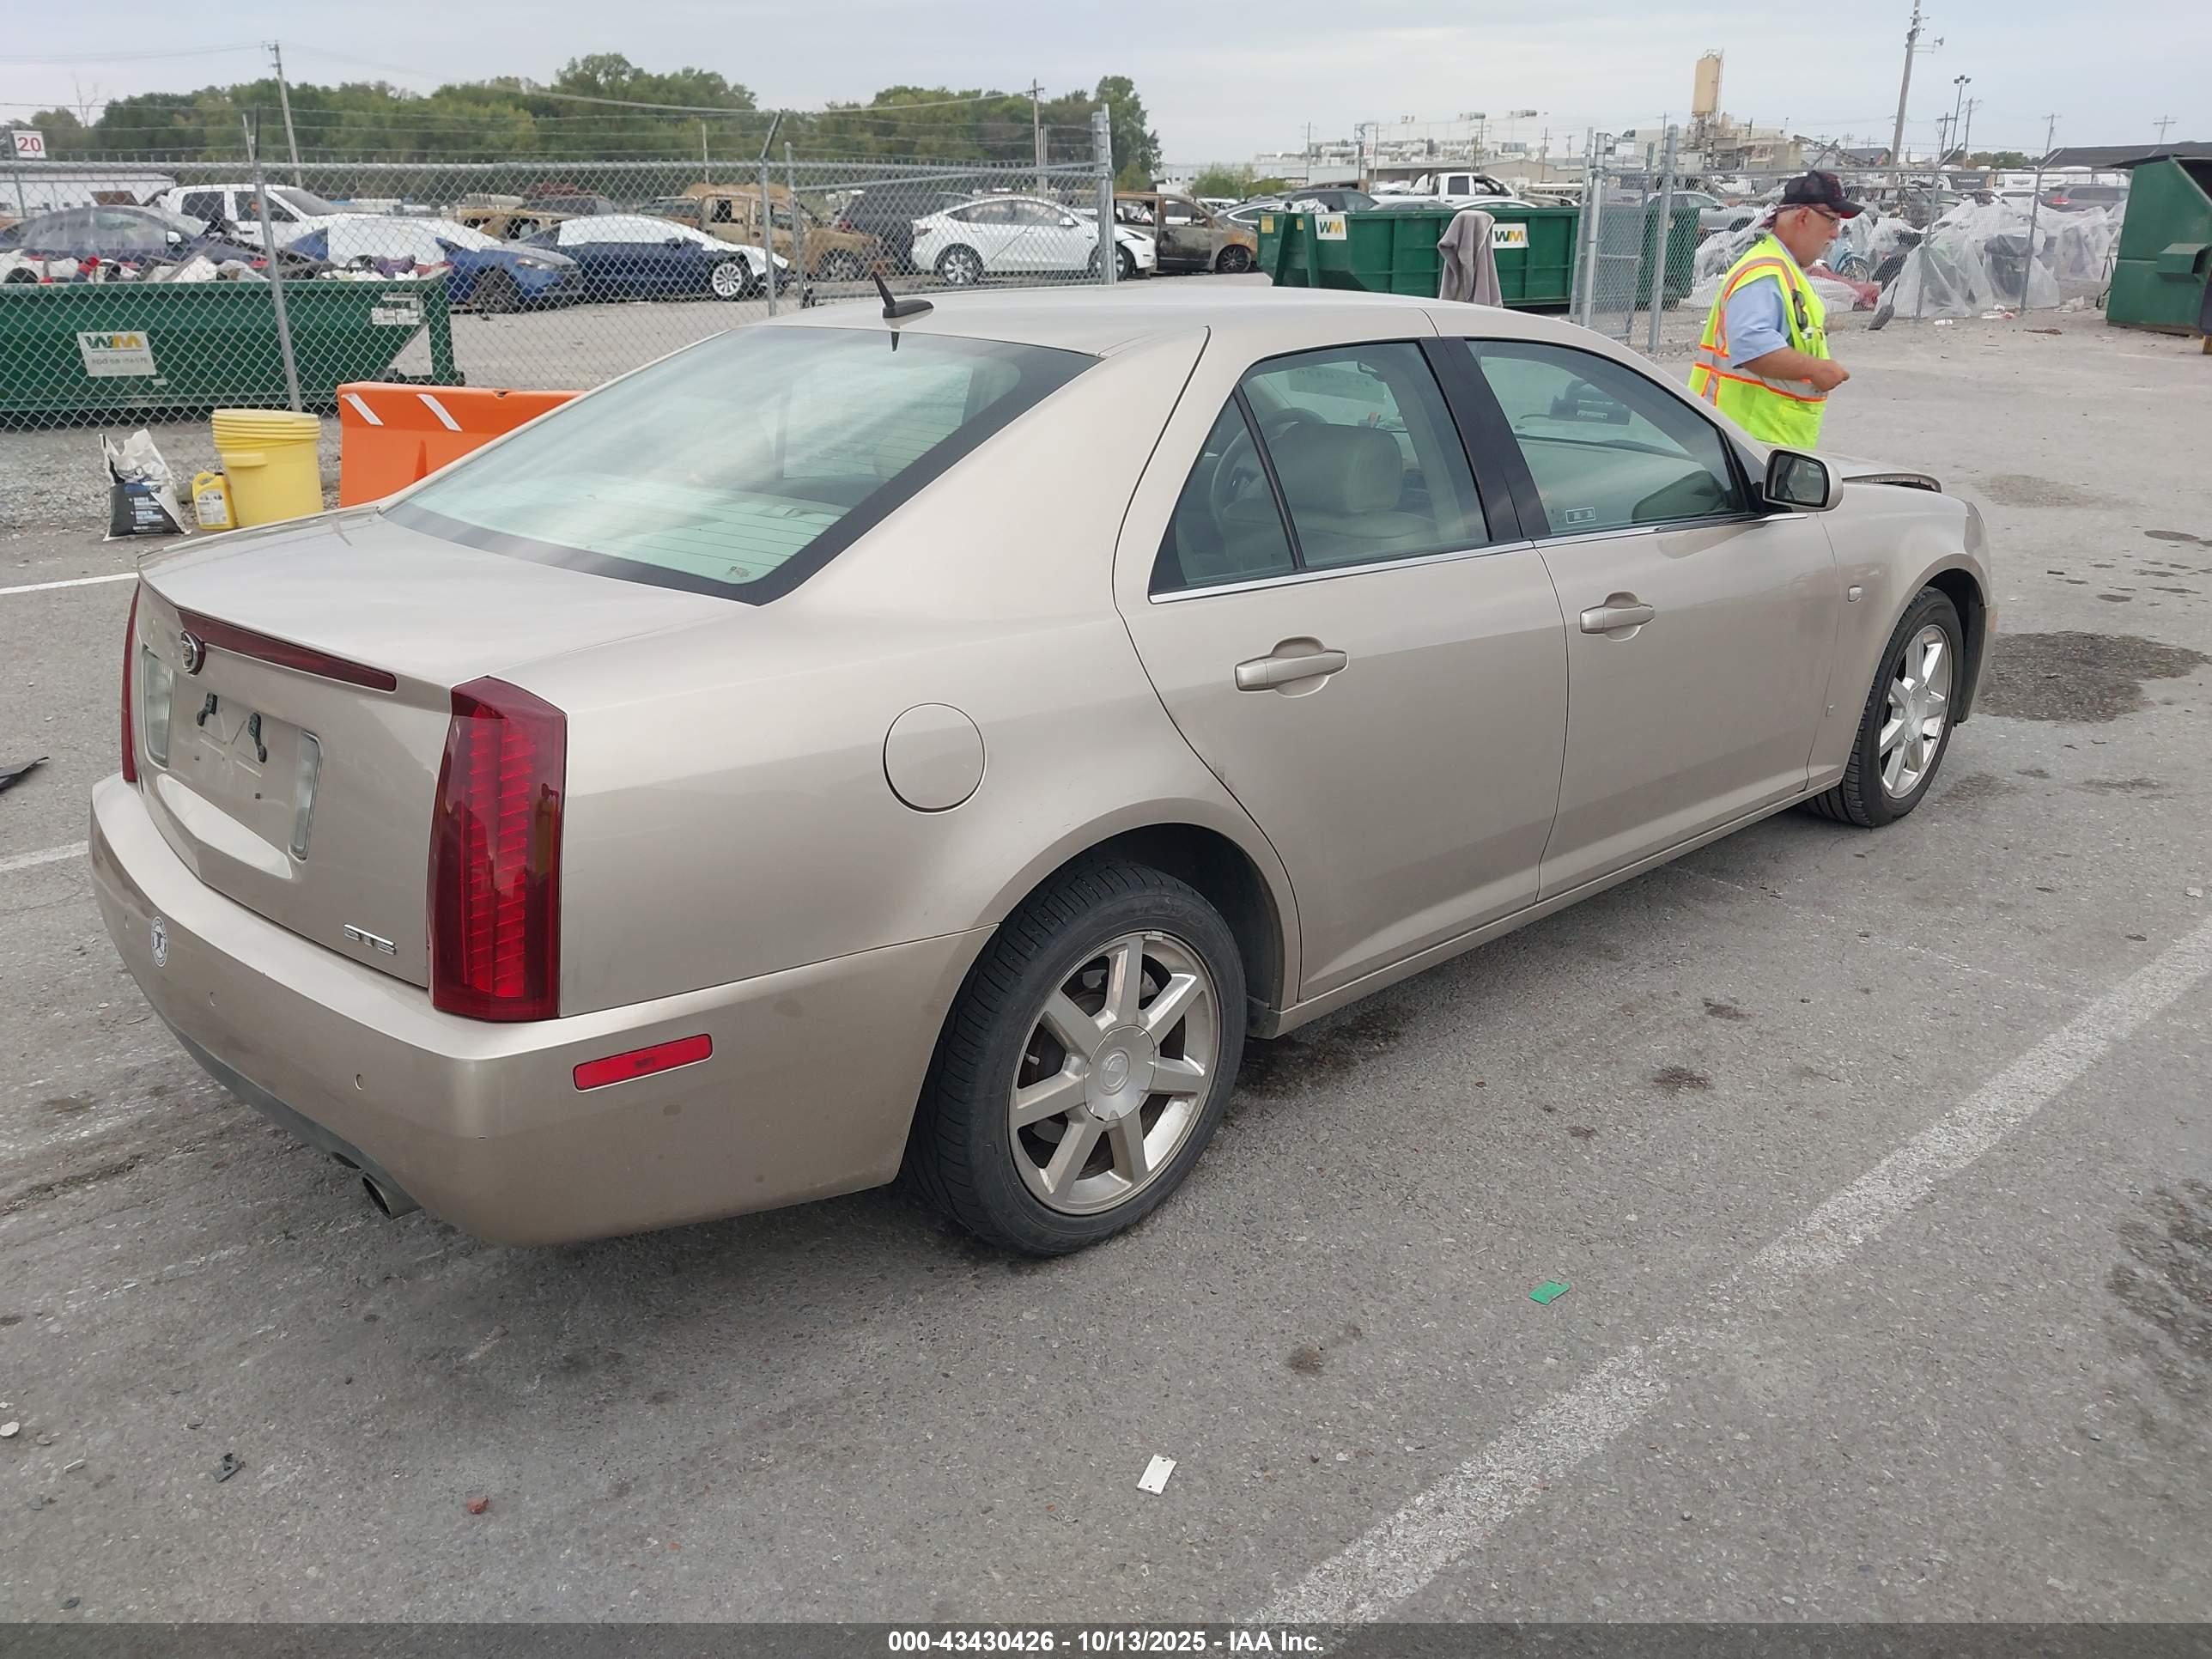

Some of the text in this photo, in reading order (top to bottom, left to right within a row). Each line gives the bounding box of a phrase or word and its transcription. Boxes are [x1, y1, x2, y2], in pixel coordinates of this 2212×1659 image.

[18, 137, 41, 152] 20
[1319, 221, 1342, 234] WM
[1494, 230, 1523, 242] WM
[83, 335, 143, 349] WM
[343, 924, 397, 955] STS
